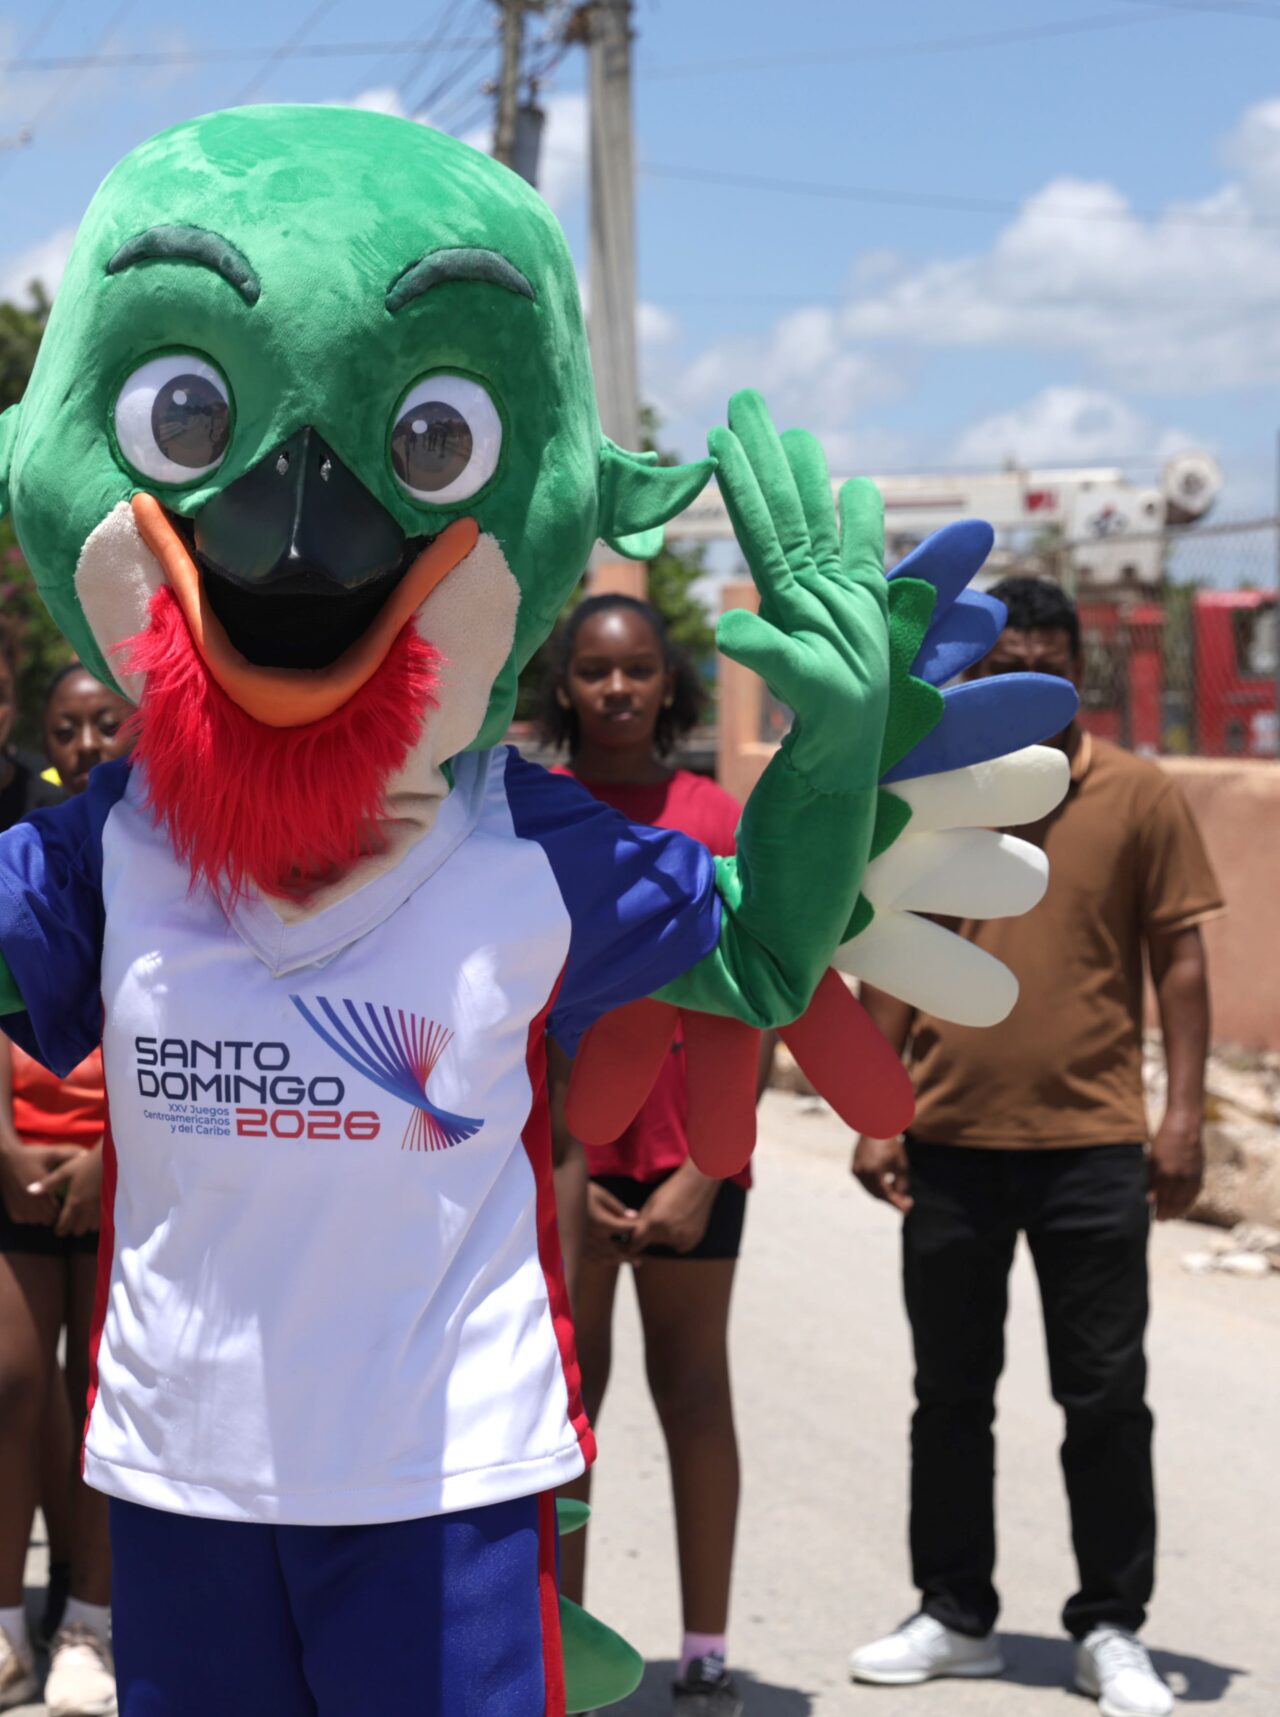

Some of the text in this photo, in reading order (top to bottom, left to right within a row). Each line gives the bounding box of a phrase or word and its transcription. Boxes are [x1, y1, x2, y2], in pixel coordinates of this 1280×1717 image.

[135, 1036, 290, 1071] SANTO
[137, 1068, 345, 1106] DOMINGO
[143, 1109, 230, 1126] Centroamericanos
[168, 1103, 230, 1117] XXV Juegos
[170, 1124, 231, 1136] y del Caribe
[235, 1107, 381, 1141] 2026
